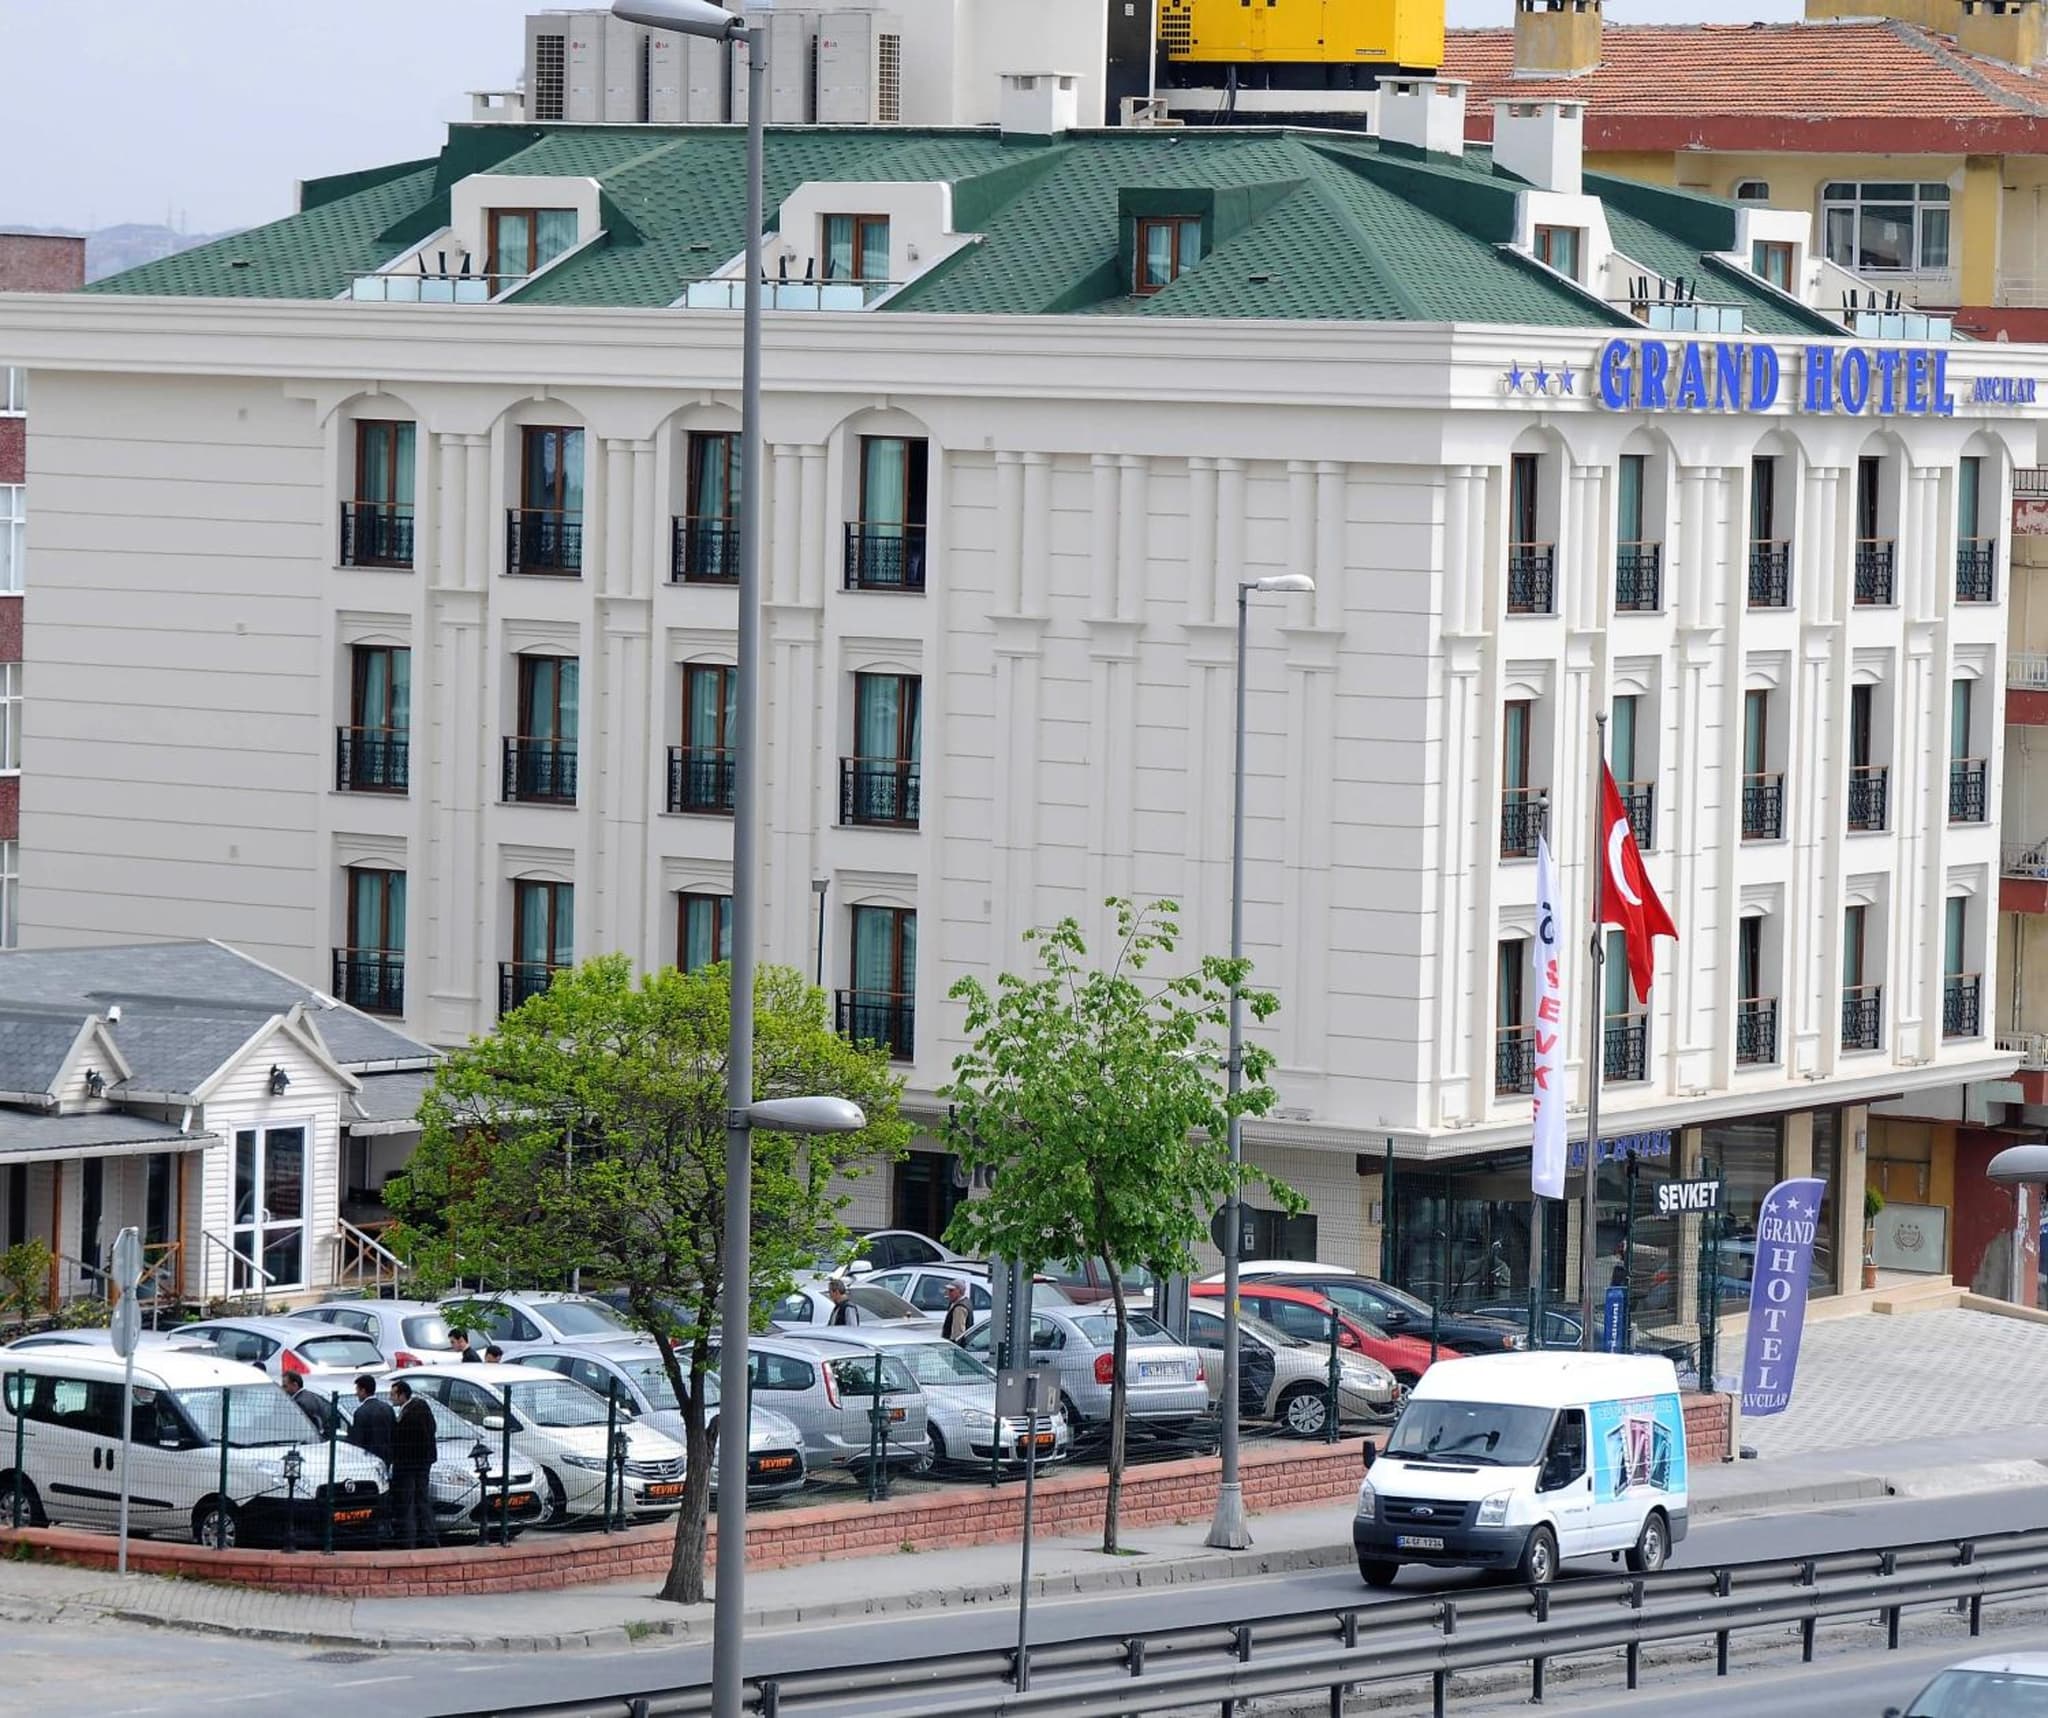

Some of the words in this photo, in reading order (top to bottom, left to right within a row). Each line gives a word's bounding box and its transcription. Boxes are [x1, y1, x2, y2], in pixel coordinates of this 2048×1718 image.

[1600, 338, 1779, 411] GRAND
[1805, 345, 1955, 415] HOTEL
[1973, 376, 2037, 404] AVCILAR
[1659, 1181, 1719, 1214] ŞEVKET
[1762, 1216, 1816, 1246] GRAND
[1757, 1247, 1798, 1390] HOTEL
[1741, 1392, 1788, 1409] AVCILAR
